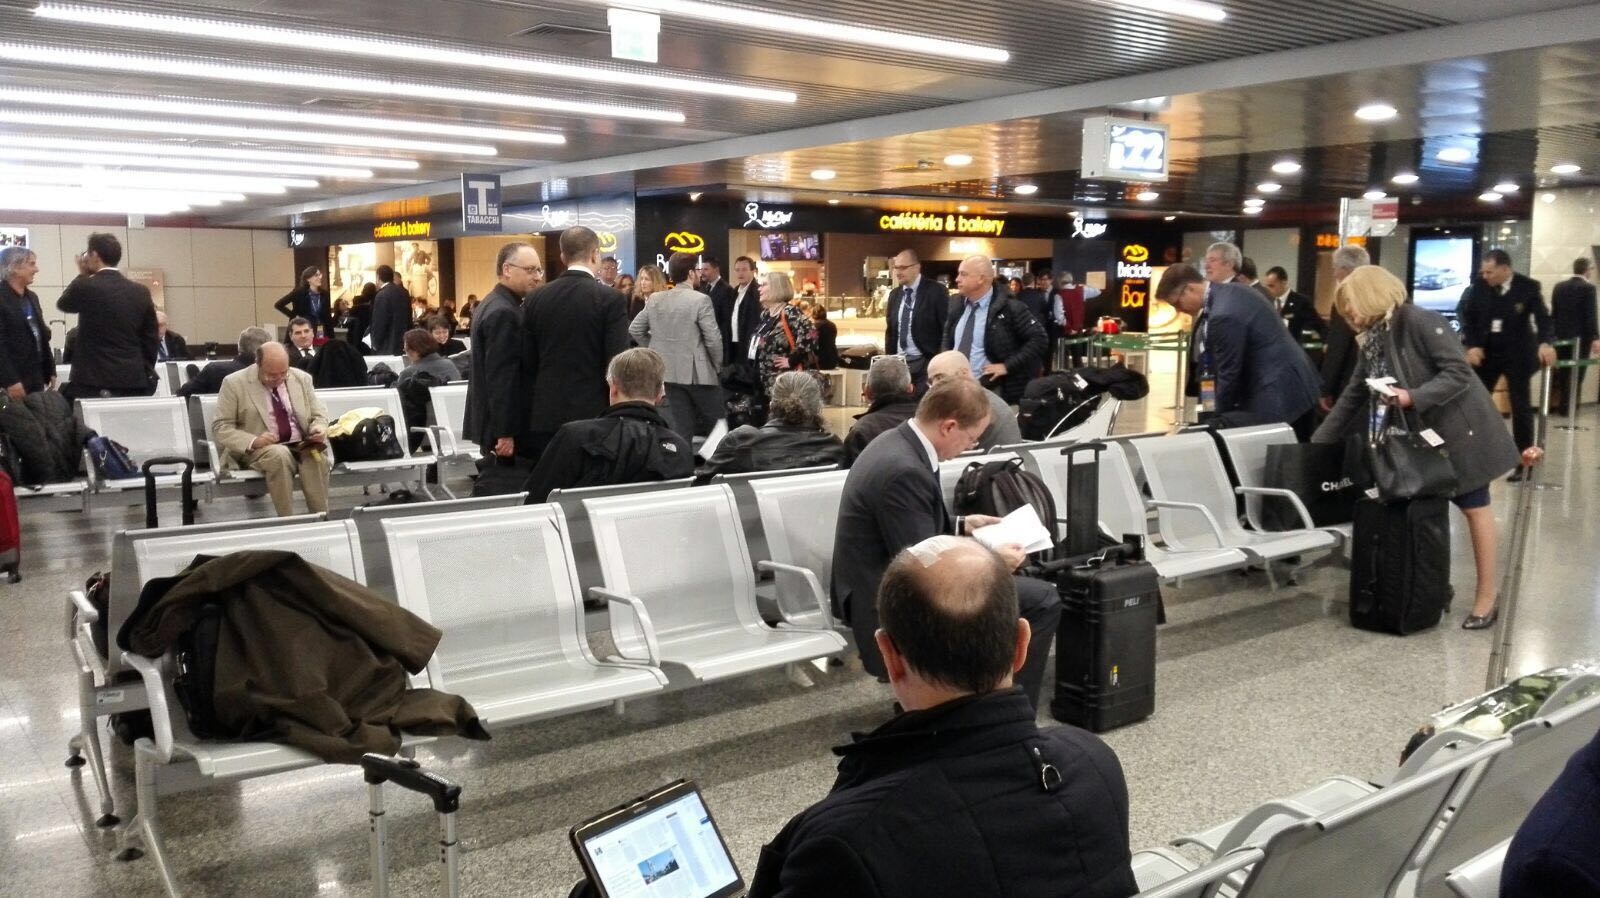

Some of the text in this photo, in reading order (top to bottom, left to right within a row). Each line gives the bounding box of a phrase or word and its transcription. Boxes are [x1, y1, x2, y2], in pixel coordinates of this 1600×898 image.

[469, 180, 495, 215] T
[401, 221, 407, 236] &
[407, 220, 431, 237] bakery
[467, 215, 500, 224] TABACCHI
[880, 211, 1005, 236] cafétéria & bakery
[1121, 284, 1146, 307] Bar
[1124, 597, 1140, 608] PELI
